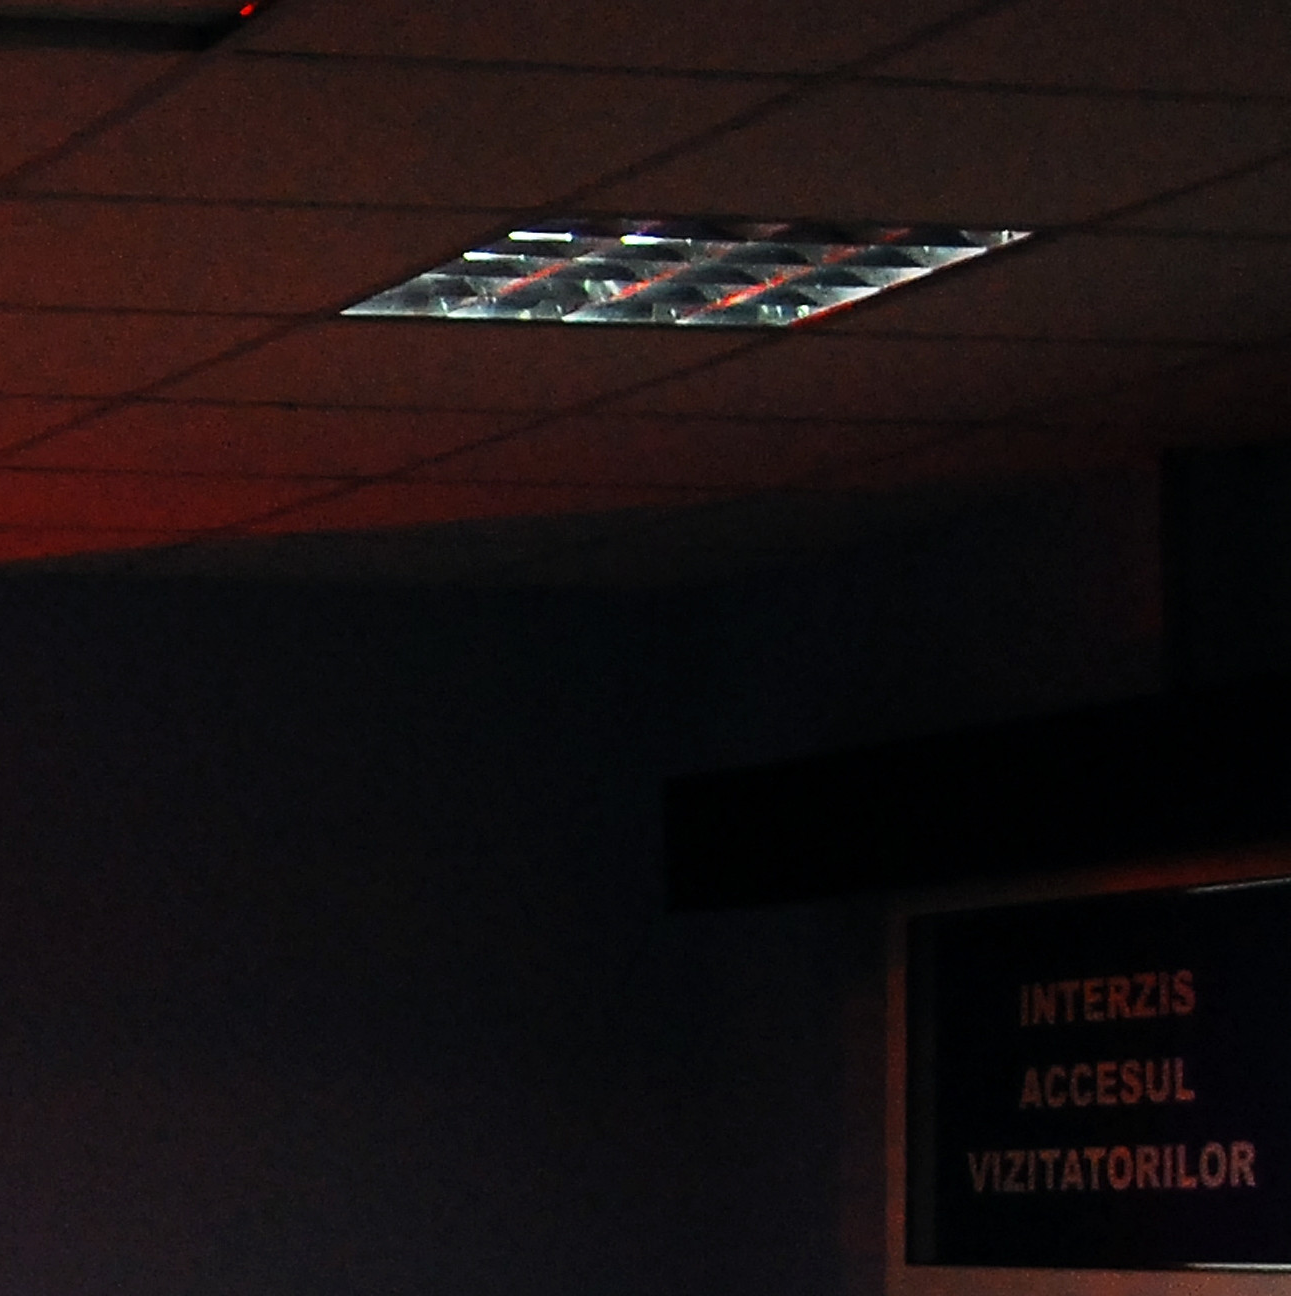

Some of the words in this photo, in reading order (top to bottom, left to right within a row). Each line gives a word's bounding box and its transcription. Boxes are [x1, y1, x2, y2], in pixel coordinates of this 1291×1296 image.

[1020, 968, 1196, 1027] INTERZIS
[1019, 1056, 1196, 1110] ACCESUL
[966, 1139, 1258, 1194] VIZITATORILOR
